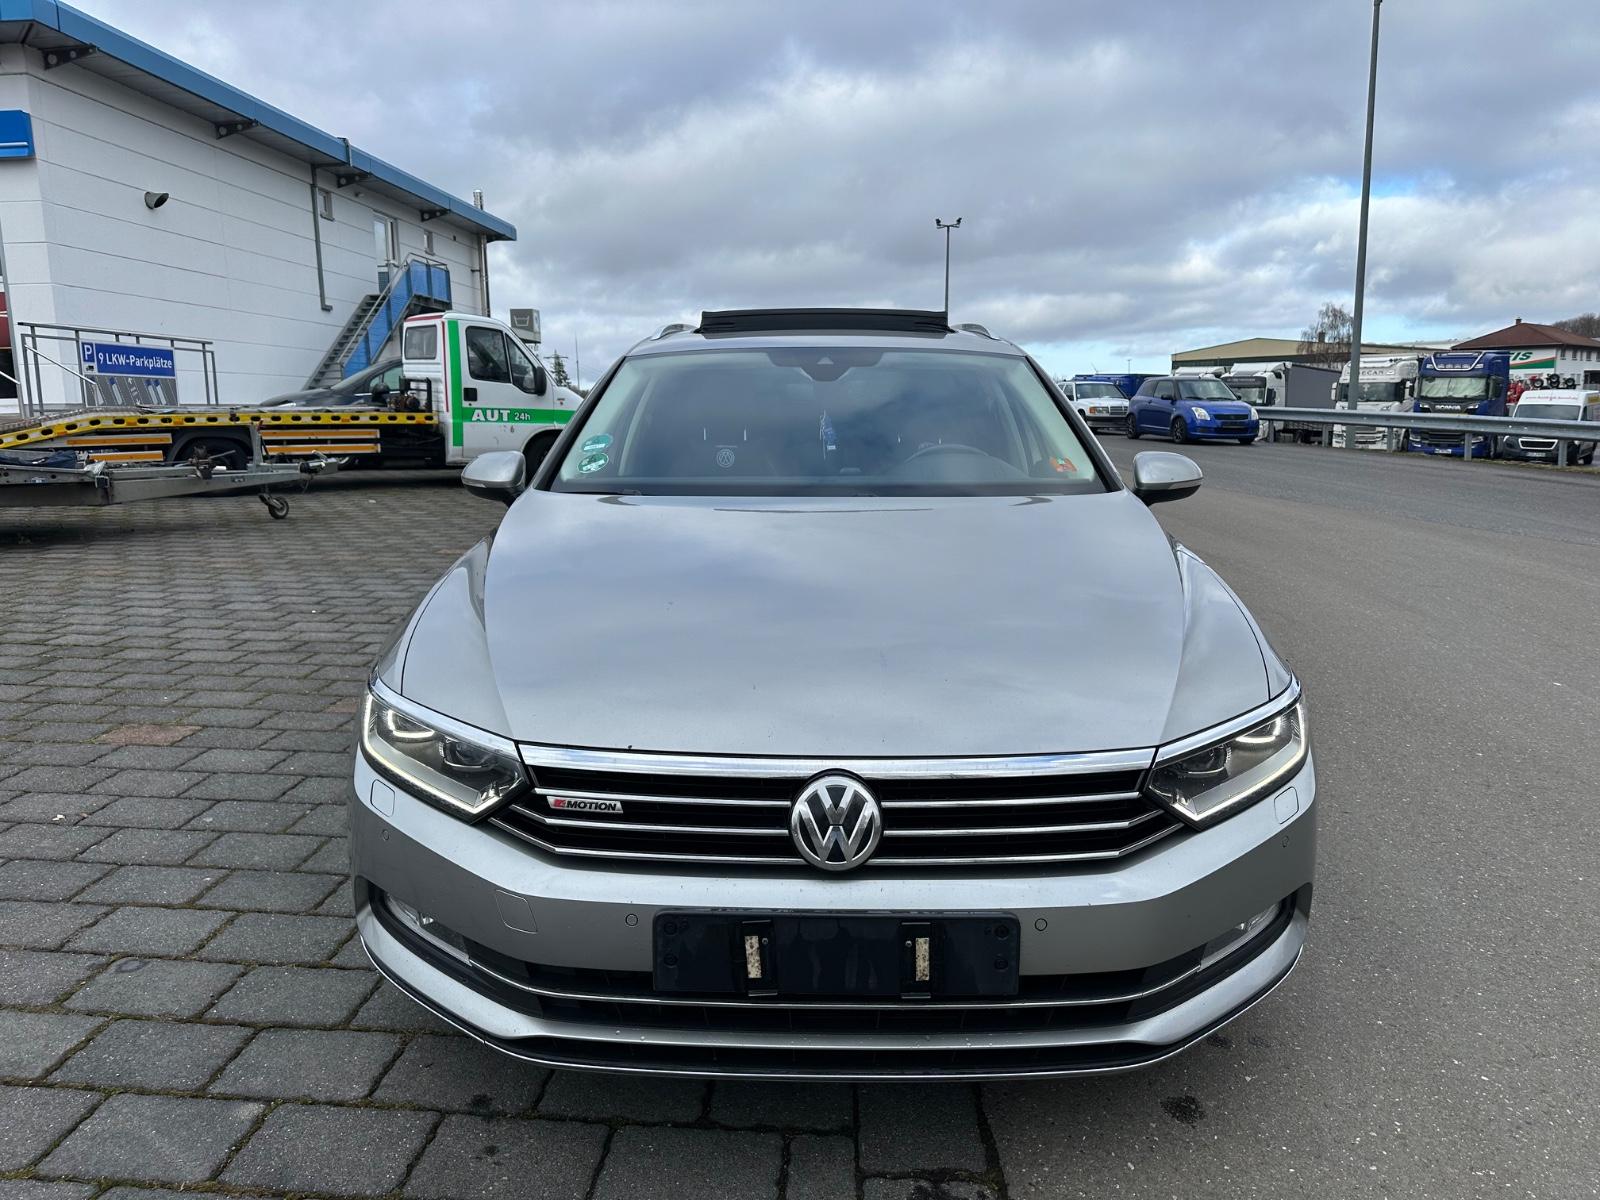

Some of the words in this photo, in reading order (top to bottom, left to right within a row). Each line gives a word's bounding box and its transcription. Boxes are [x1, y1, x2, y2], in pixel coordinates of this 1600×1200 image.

[84, 344, 93, 360] P
[98, 352, 104, 364] 9
[105, 353, 173, 369] LKW-Parkplätze
[471, 409, 511, 421] AUT
[514, 413, 531, 421] 24h
[793, 777, 879, 869] VW
